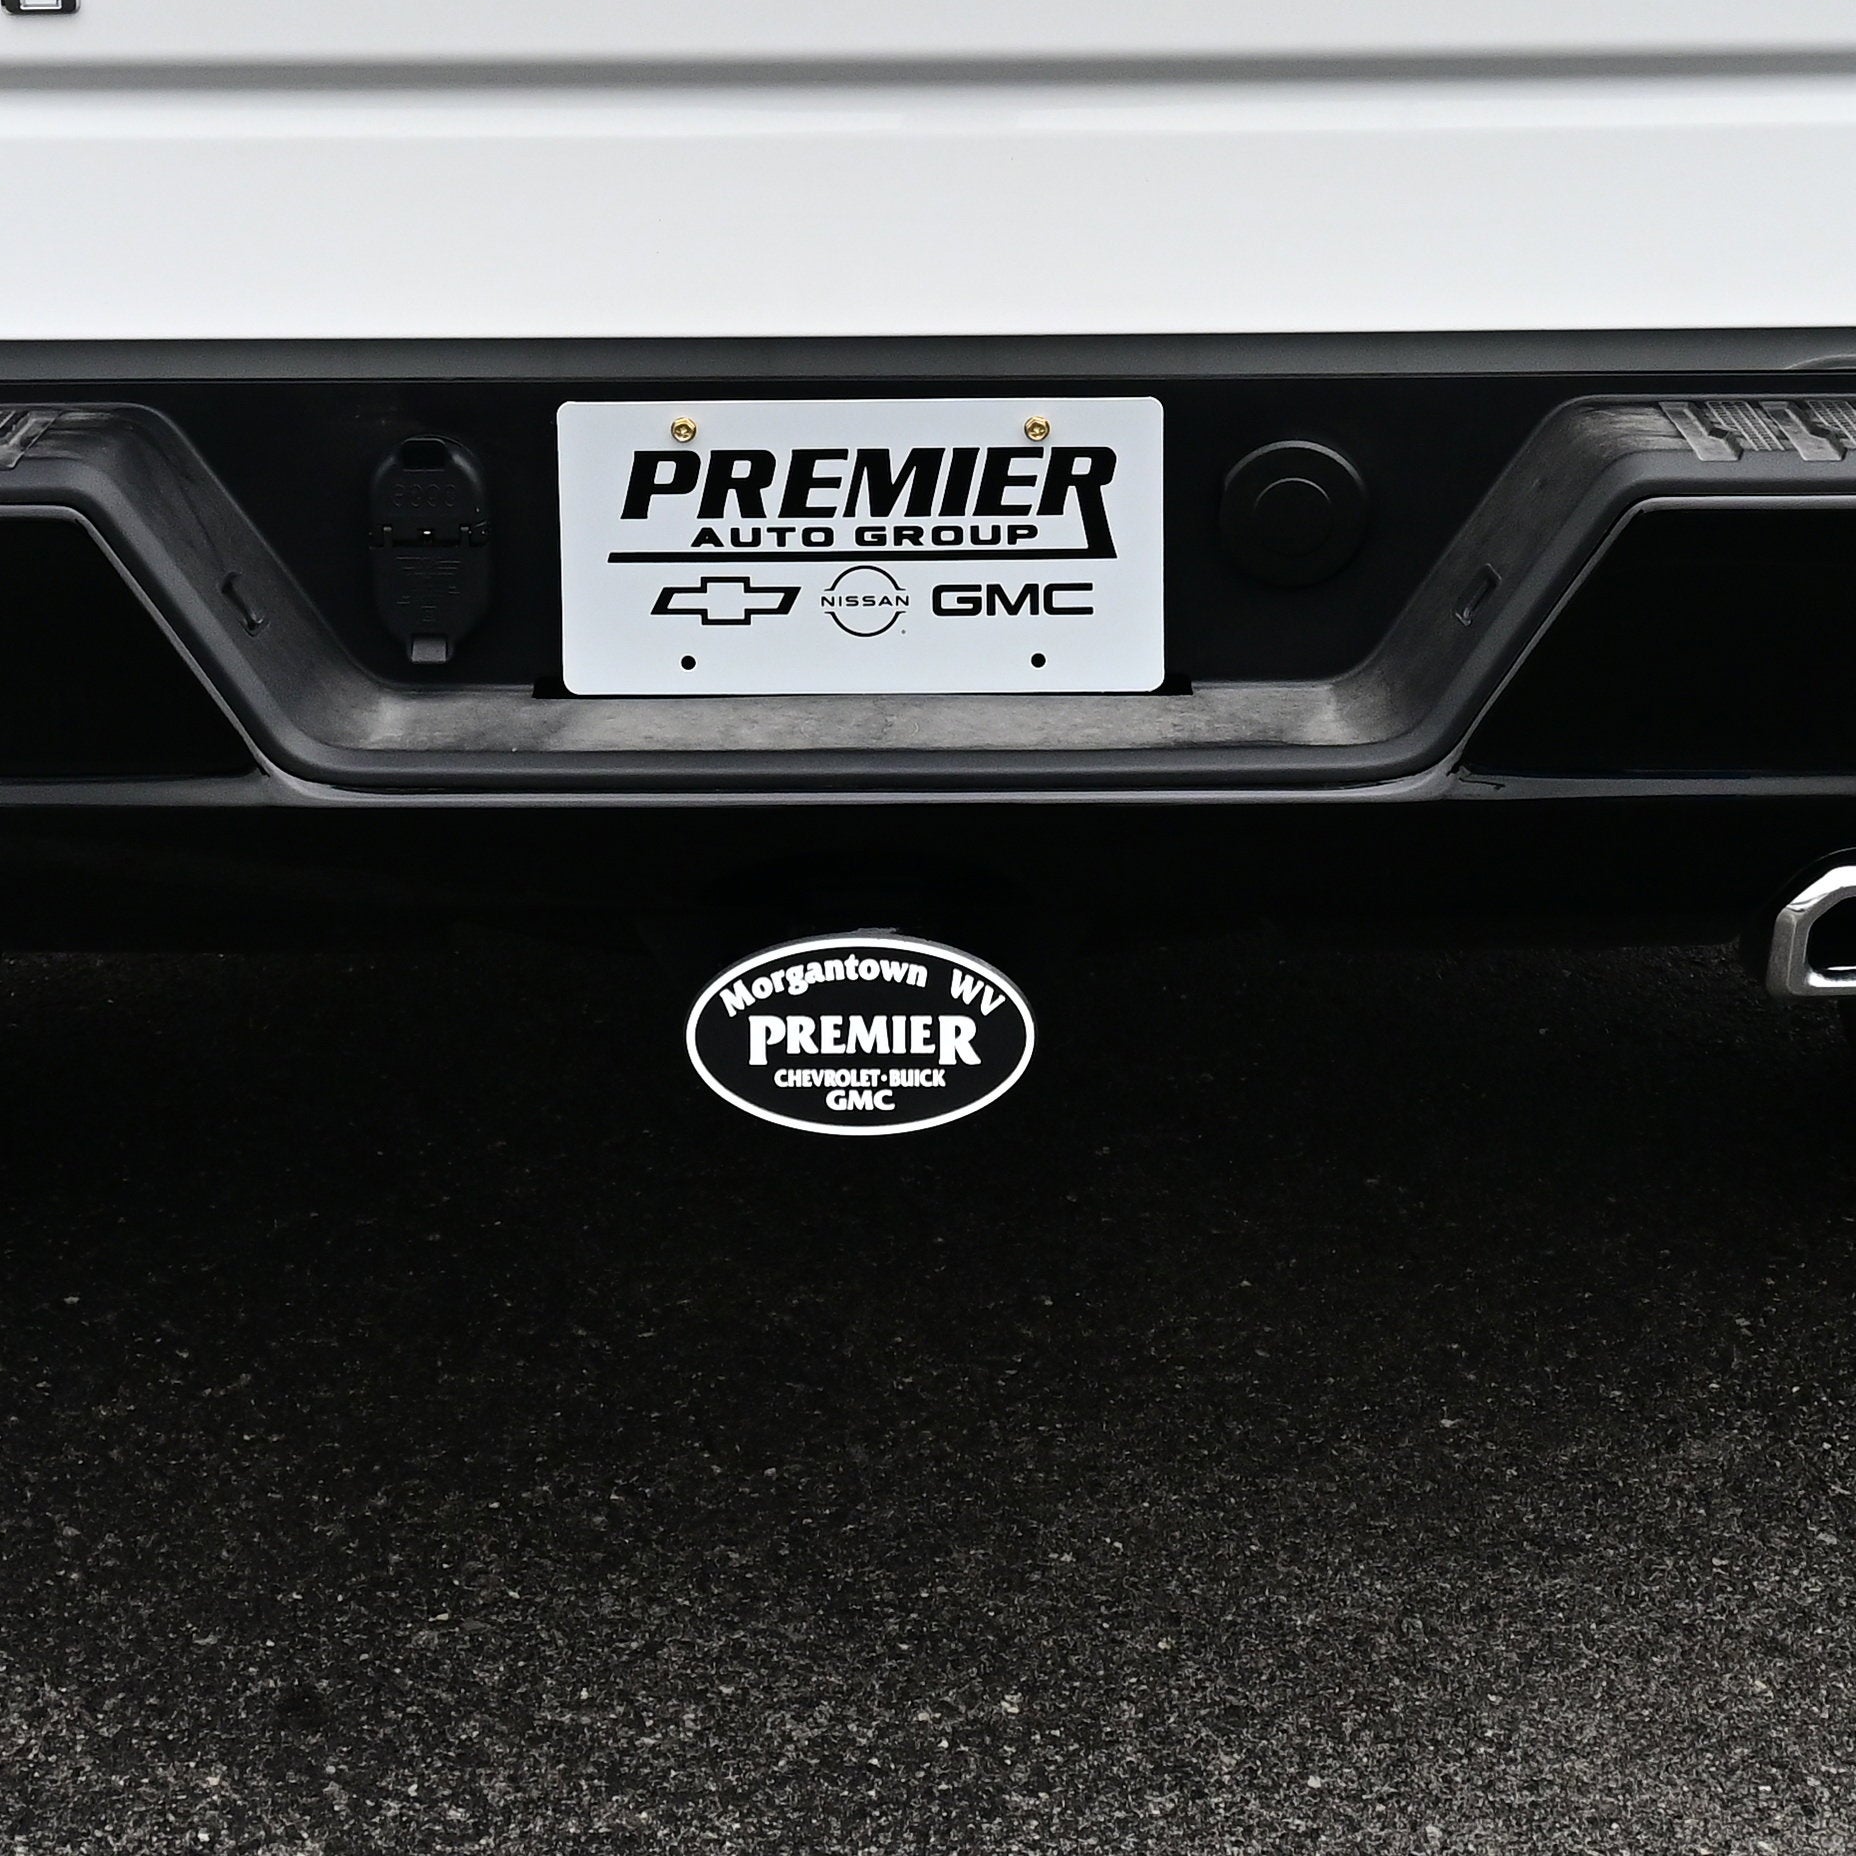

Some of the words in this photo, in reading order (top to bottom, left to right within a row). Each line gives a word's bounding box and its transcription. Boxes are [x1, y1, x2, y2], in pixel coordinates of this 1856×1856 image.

[620, 445, 1119, 559] PREMIER
[690, 525, 835, 549] AUTO
[854, 523, 1040, 548] GROUP
[820, 594, 911, 609] NISSAN
[931, 582, 1095, 617] GMC
[718, 953, 929, 1017] Morgantown
[949, 968, 1007, 1017] WV
[747, 1014, 982, 1067] PREMIER
[825, 1089, 896, 1111] GMC
